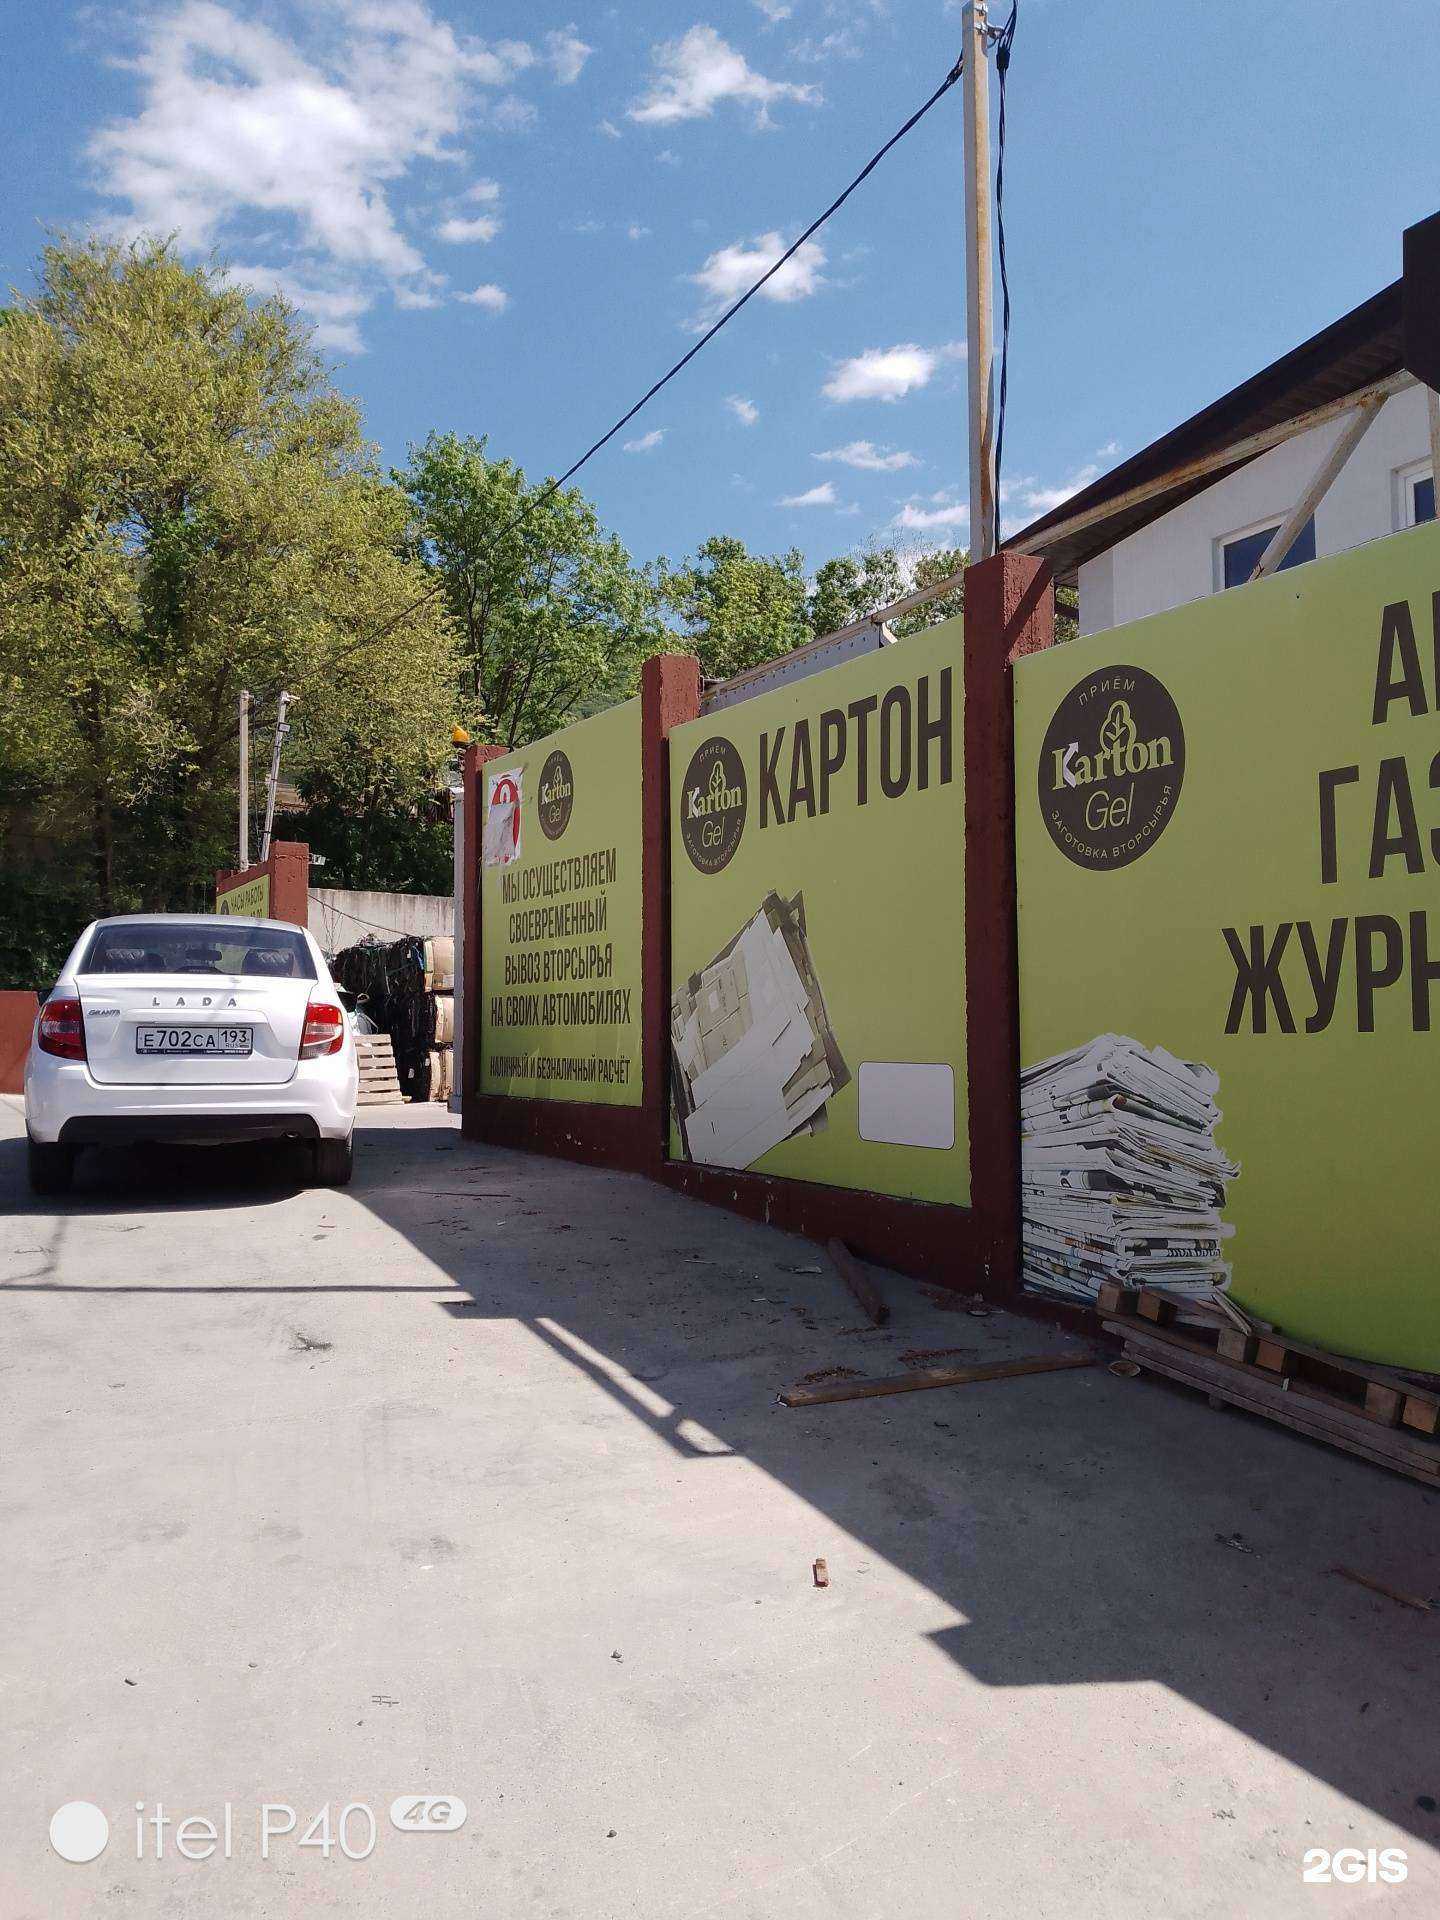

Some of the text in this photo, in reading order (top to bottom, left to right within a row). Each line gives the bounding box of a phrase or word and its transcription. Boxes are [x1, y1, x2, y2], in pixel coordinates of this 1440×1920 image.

[1371, 590, 1440, 726] А
[759, 666, 953, 830] КАРТОН
[1050, 735, 1175, 791] Karton
[541, 782, 572, 805] Karton
[686, 786, 743, 819] Karton
[1084, 782, 1135, 831] Gel
[701, 815, 726, 848] Gel
[1051, 784, 1173, 860] ЗАГОТОВКА ВТОРСЫРЬЯ
[502, 848, 617, 904] МЫ ОСУЩЕСТВЛЯЕМ
[509, 889, 607, 944] СВОЕВРЕМЕННЫЙ
[505, 943, 613, 985] ВЫВОЗ ВТОРСЫРЬЯ
[152, 997, 237, 1007] LADA
[491, 989, 632, 1027] НА СВОИХ АВТОМОБИЛЯХ
[220, 1030, 247, 1043] 193
[490, 1053, 631, 1085] НАЛИЧНЫЙ И БЕЗНАЛИЧНЫЙ РАСЧЁТ
